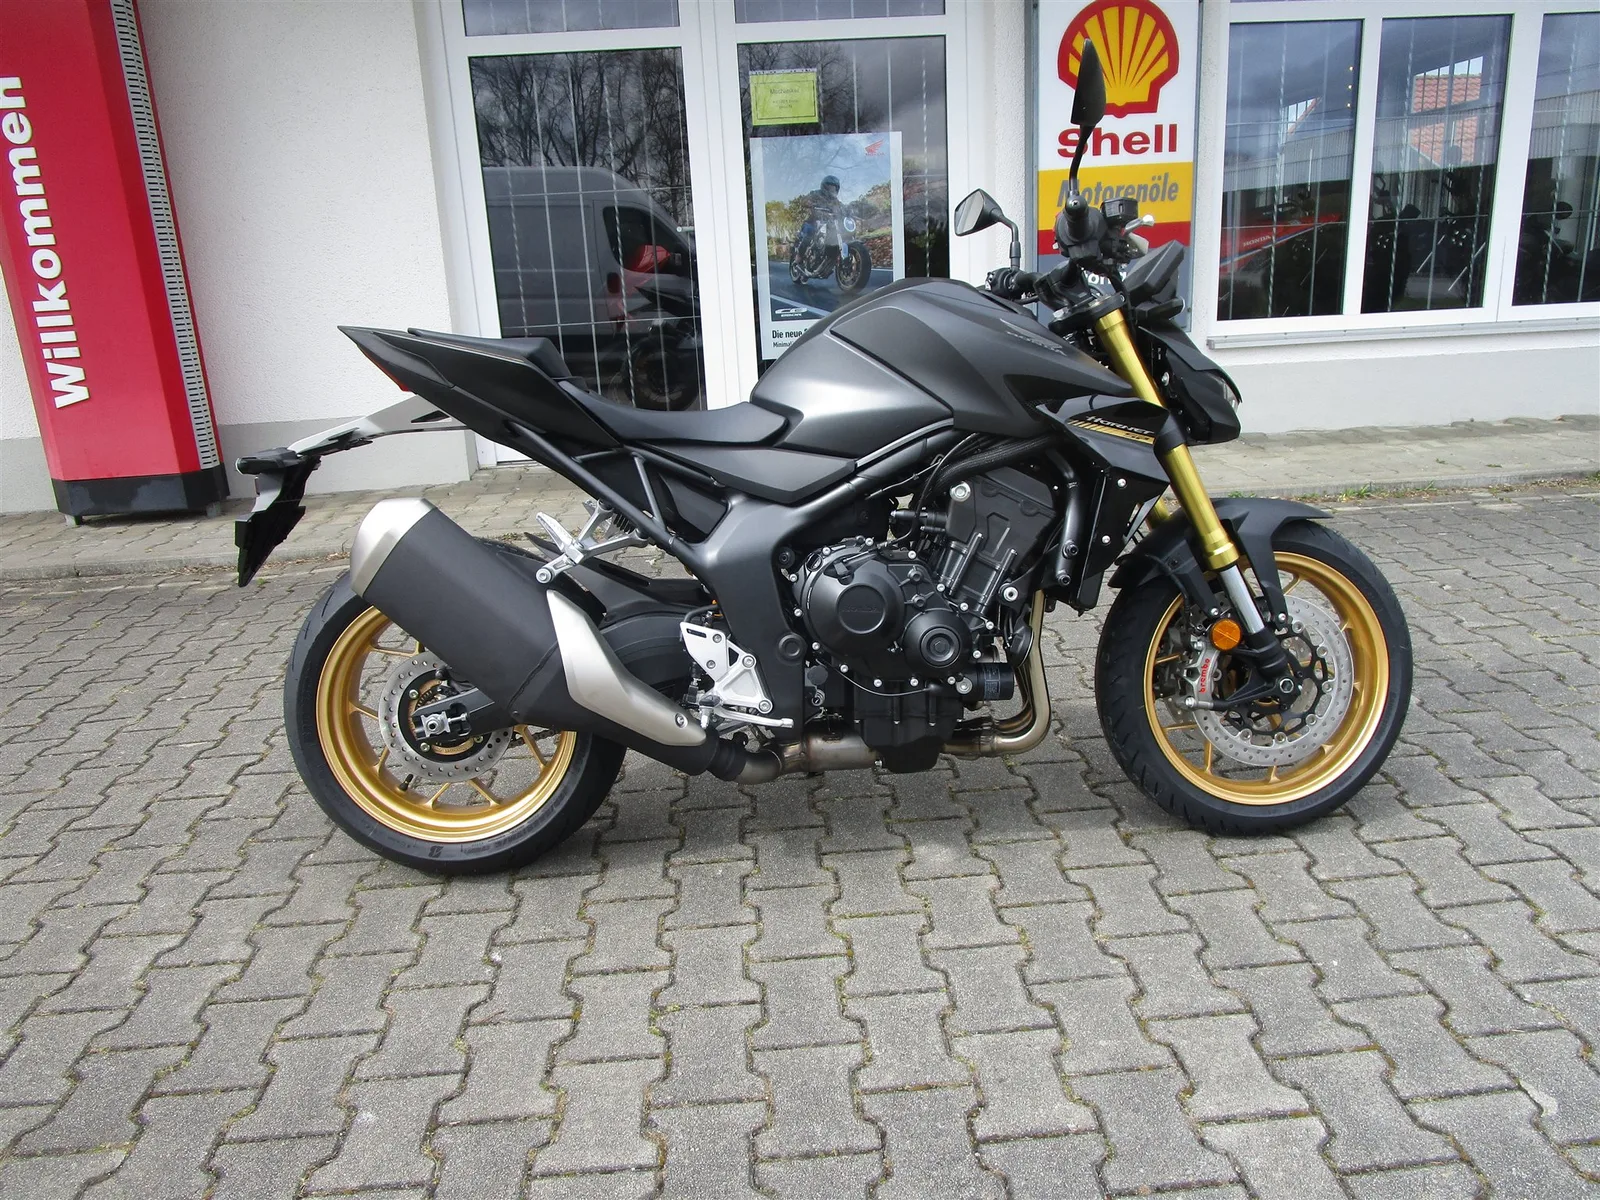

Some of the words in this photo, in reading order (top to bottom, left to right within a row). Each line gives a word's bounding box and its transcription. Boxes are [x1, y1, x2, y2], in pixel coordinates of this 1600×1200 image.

[1057, 124, 1178, 158] Shell
[0, 77, 90, 409] Willkommen
[1242, 235, 1272, 247] HONDA
[771, 329, 784, 339] Die
[785, 330, 803, 338] neue
[1199, 658, 1211, 693] brembo
